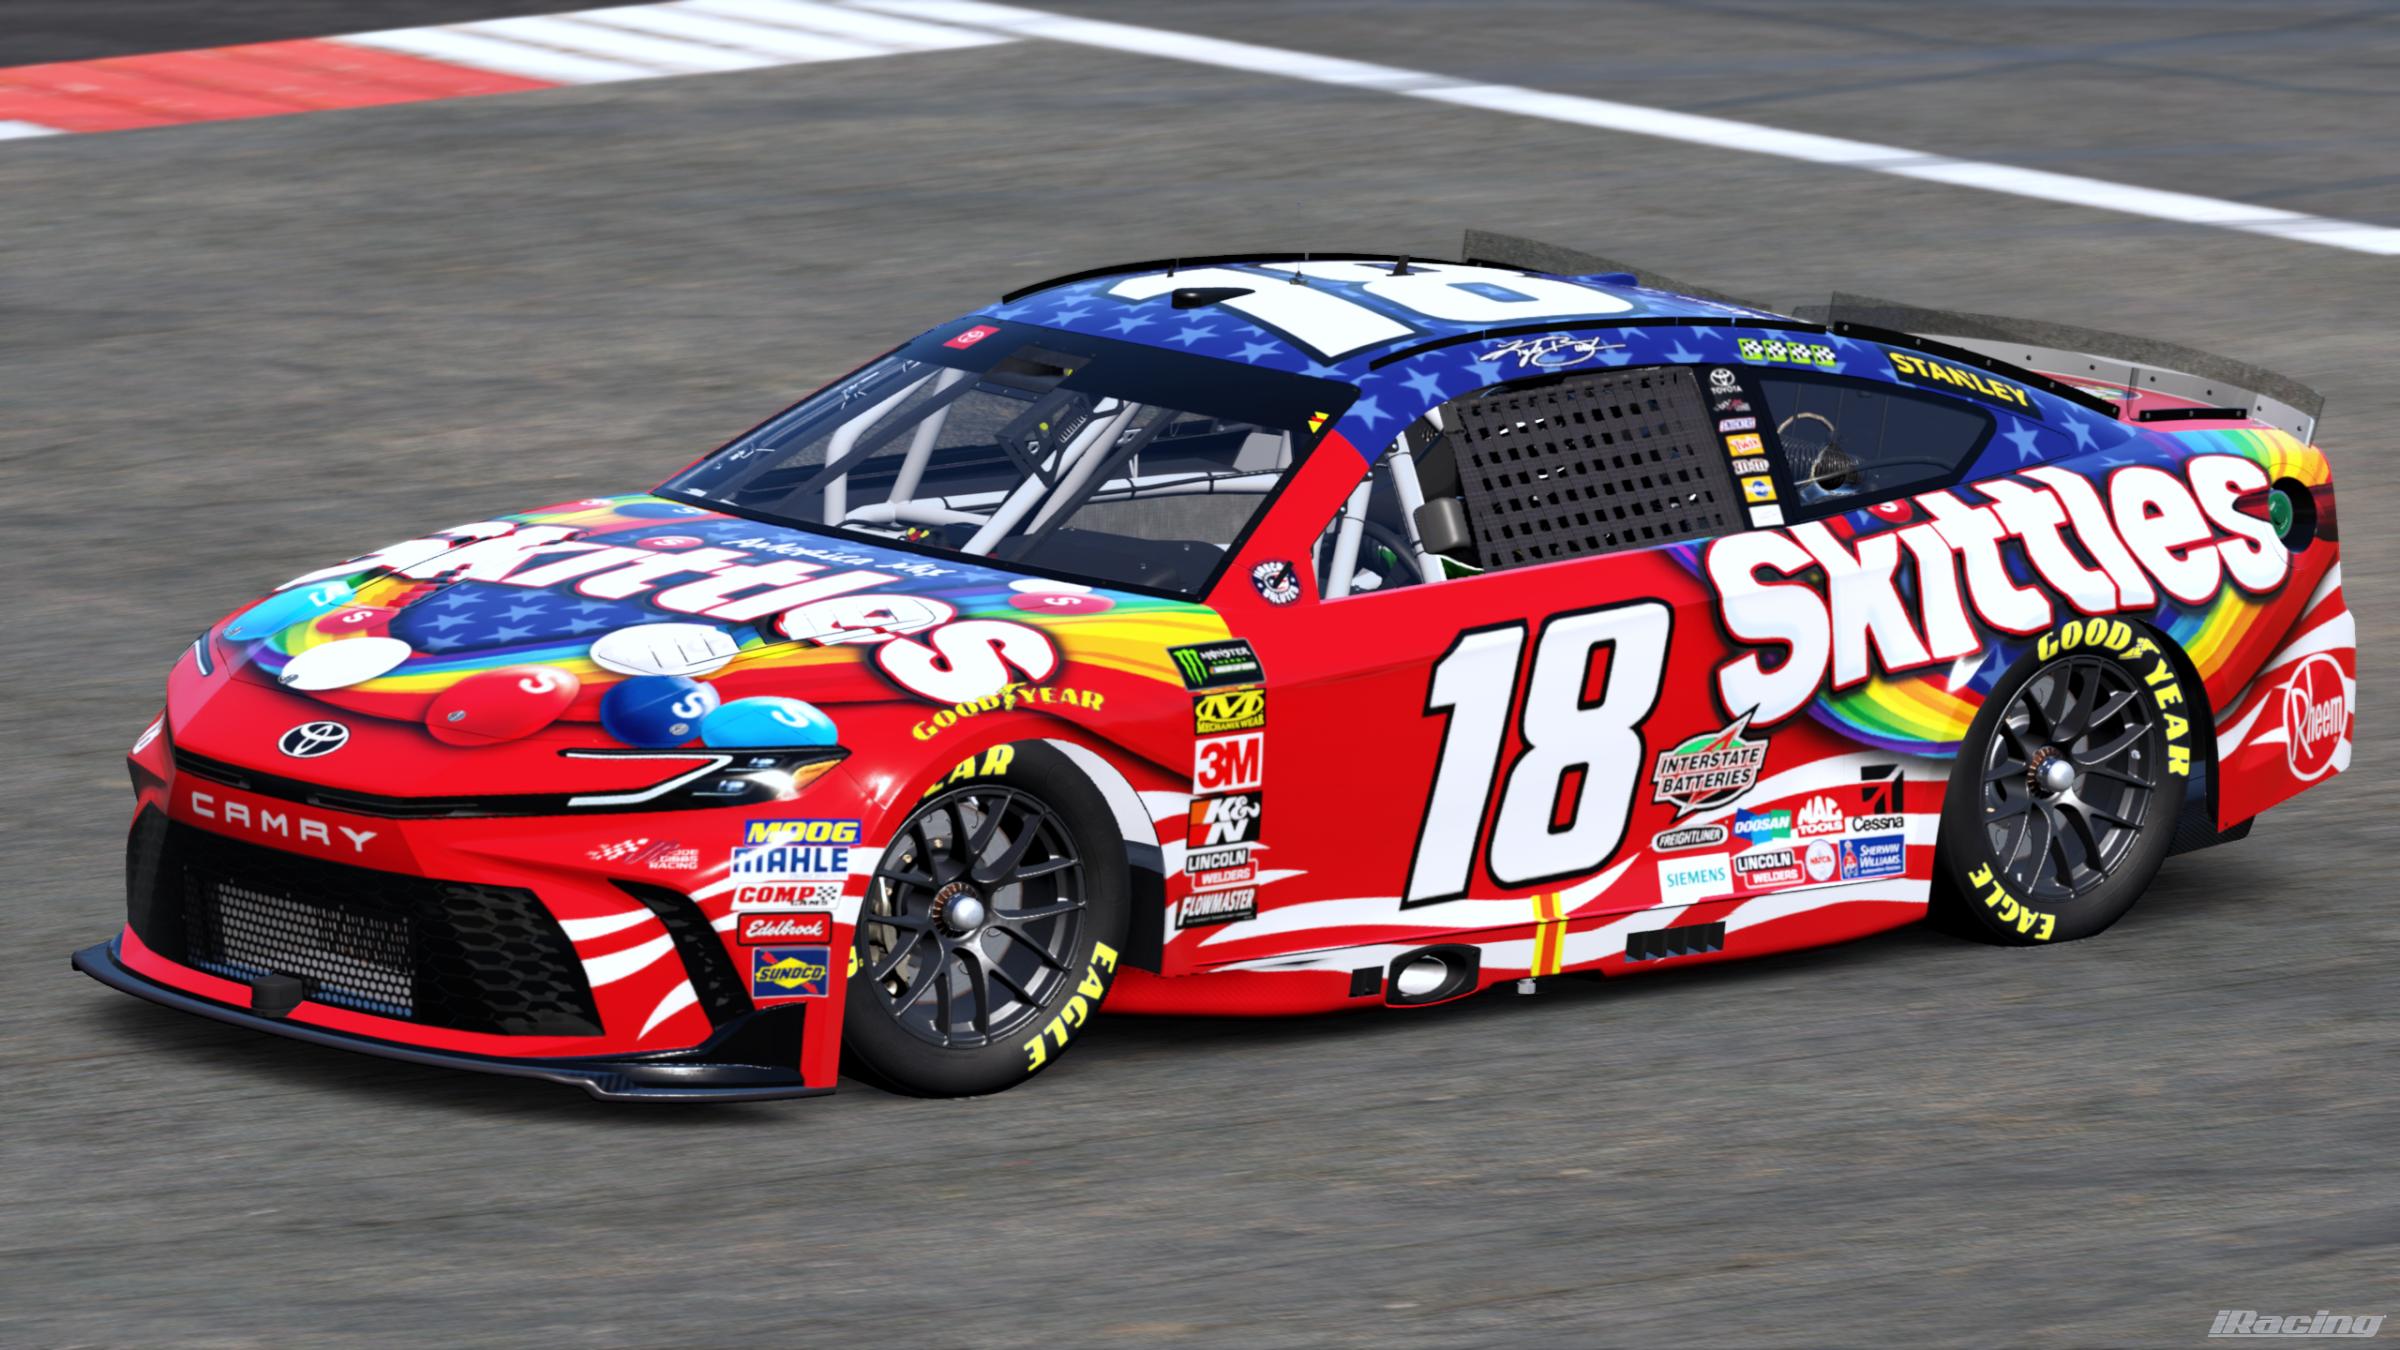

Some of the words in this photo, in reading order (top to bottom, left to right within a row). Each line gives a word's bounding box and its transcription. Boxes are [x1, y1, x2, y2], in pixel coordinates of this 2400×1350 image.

[1105, 259, 1636, 362] 18
[1710, 385, 1743, 395] TOYOTA
[1889, 351, 2030, 407] STANLEY
[1705, 454, 2289, 728] Skittles
[519, 665, 567, 695] S
[672, 690, 706, 719] S
[2290, 660, 2344, 762] Rheem
[1198, 736, 1259, 789] 3M
[1401, 598, 1673, 910] 18
[1660, 747, 1760, 774] INTERSTATE
[1661, 768, 1751, 794] BATTERIES
[191, 790, 377, 852] CAMRY
[1798, 795, 1843, 824] MAC
[747, 821, 859, 844] MOOG
[1735, 815, 1791, 833] DOOSAN
[1799, 820, 1844, 836] TOOLS
[1852, 815, 1905, 832] Cessna
[1658, 827, 1722, 848] FREIGHTLINER
[1860, 843, 1900, 857] SHERWIN
[733, 847, 849, 873] MAHLE
[1187, 849, 1247, 871] LINCOLN
[1736, 853, 1792, 871] LINCOLN
[1201, 867, 1251, 886] WELDERS
[1666, 867, 1726, 888] SIEMENS
[1753, 868, 1798, 883] WELDERS
[738, 886, 816, 903] COMP
[1177, 888, 1256, 927] FLOWMASTER
[1968, 862, 2057, 941] EAGLE
[745, 919, 824, 938] Edelbrock
[760, 966, 823, 980] SUNOCO
[1023, 940, 1119, 1072] EAGLE
